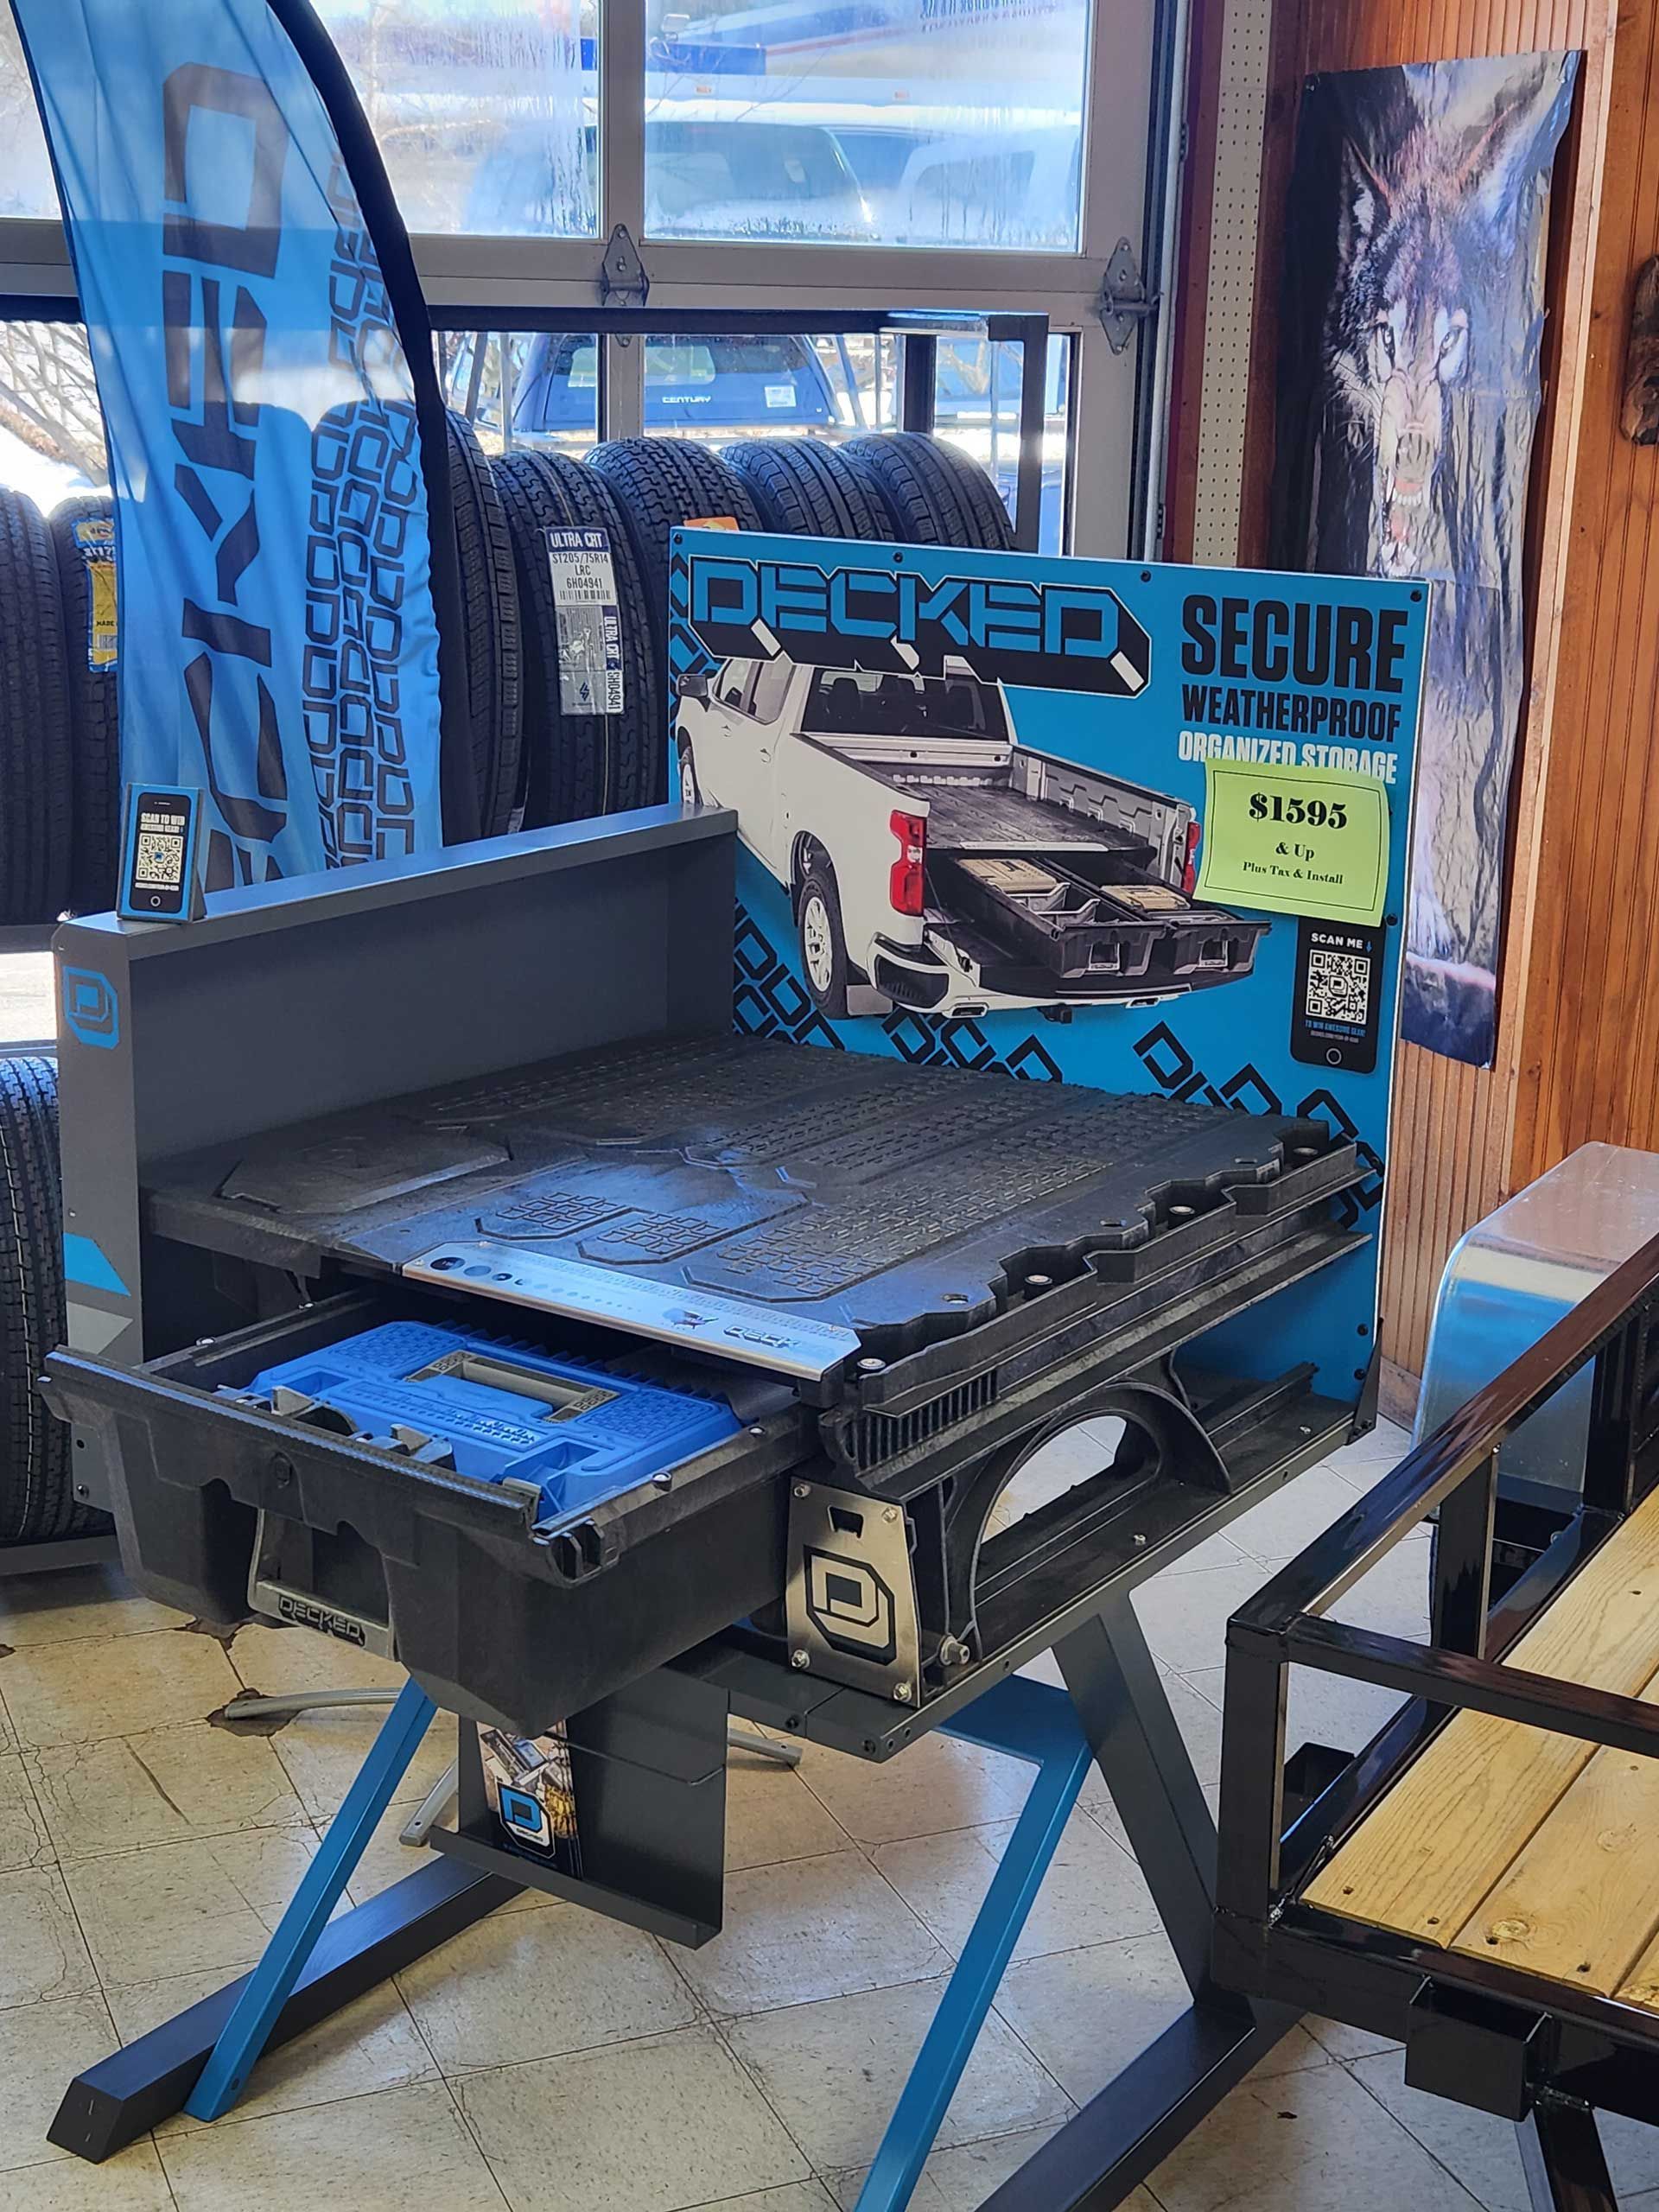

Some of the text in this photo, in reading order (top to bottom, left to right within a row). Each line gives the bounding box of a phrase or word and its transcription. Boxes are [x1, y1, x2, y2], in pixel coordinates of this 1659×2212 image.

[550, 531, 603, 549] ULTRA CRT
[552, 552, 608, 563] ST205/75R14
[575, 564, 591, 575] LRC
[566, 577, 602, 589] 6H04941
[690, 559, 1122, 660] DECKED
[604, 615, 620, 660] ULTRA CRT
[1181, 594, 1409, 694] SECURE
[1181, 683, 1402, 742] WEATHERPROOF
[1178, 730, 1398, 785] ORGANIZED STORAGE
[1249, 791, 1348, 830] $1595
[1275, 842, 1315, 862] & Up
[1243, 861, 1344, 885] Plus Tax & Install
[1311, 932, 1363, 950] SCAN ME
[279, 1596, 361, 1642] DECKED
